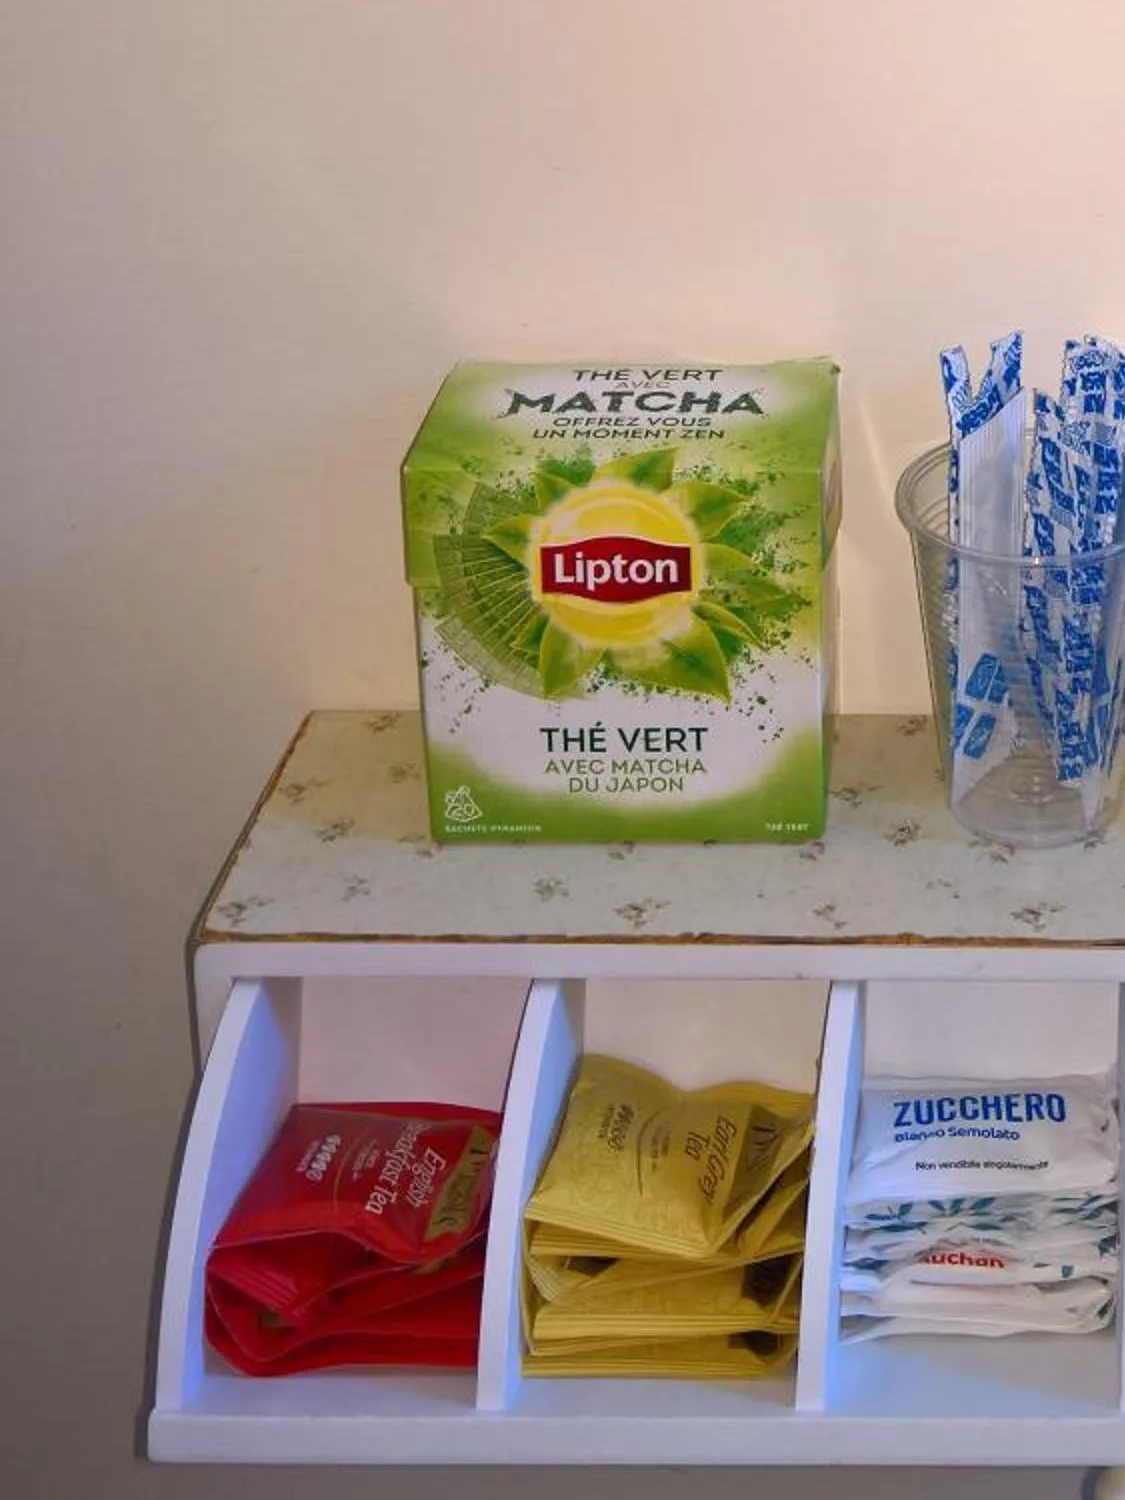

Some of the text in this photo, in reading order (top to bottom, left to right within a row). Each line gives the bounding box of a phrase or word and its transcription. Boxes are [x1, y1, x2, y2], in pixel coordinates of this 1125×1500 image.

[641, 369, 724, 381] VERT
[499, 388, 769, 417] MATCHA
[553, 417, 712, 427] OFFREZ VOUS
[533, 429, 725, 439] UN MOMENT ZEN
[554, 553, 679, 590] Lipton
[540, 721, 708, 753] THÉ VERT
[544, 759, 706, 775] AVEC MATCHA
[569, 777, 684, 793] DU JAPON
[892, 1091, 1068, 1129] ZUCCHERO
[948, 1126, 1021, 1141] Semolato
[365, 1188, 398, 1216] Tea
